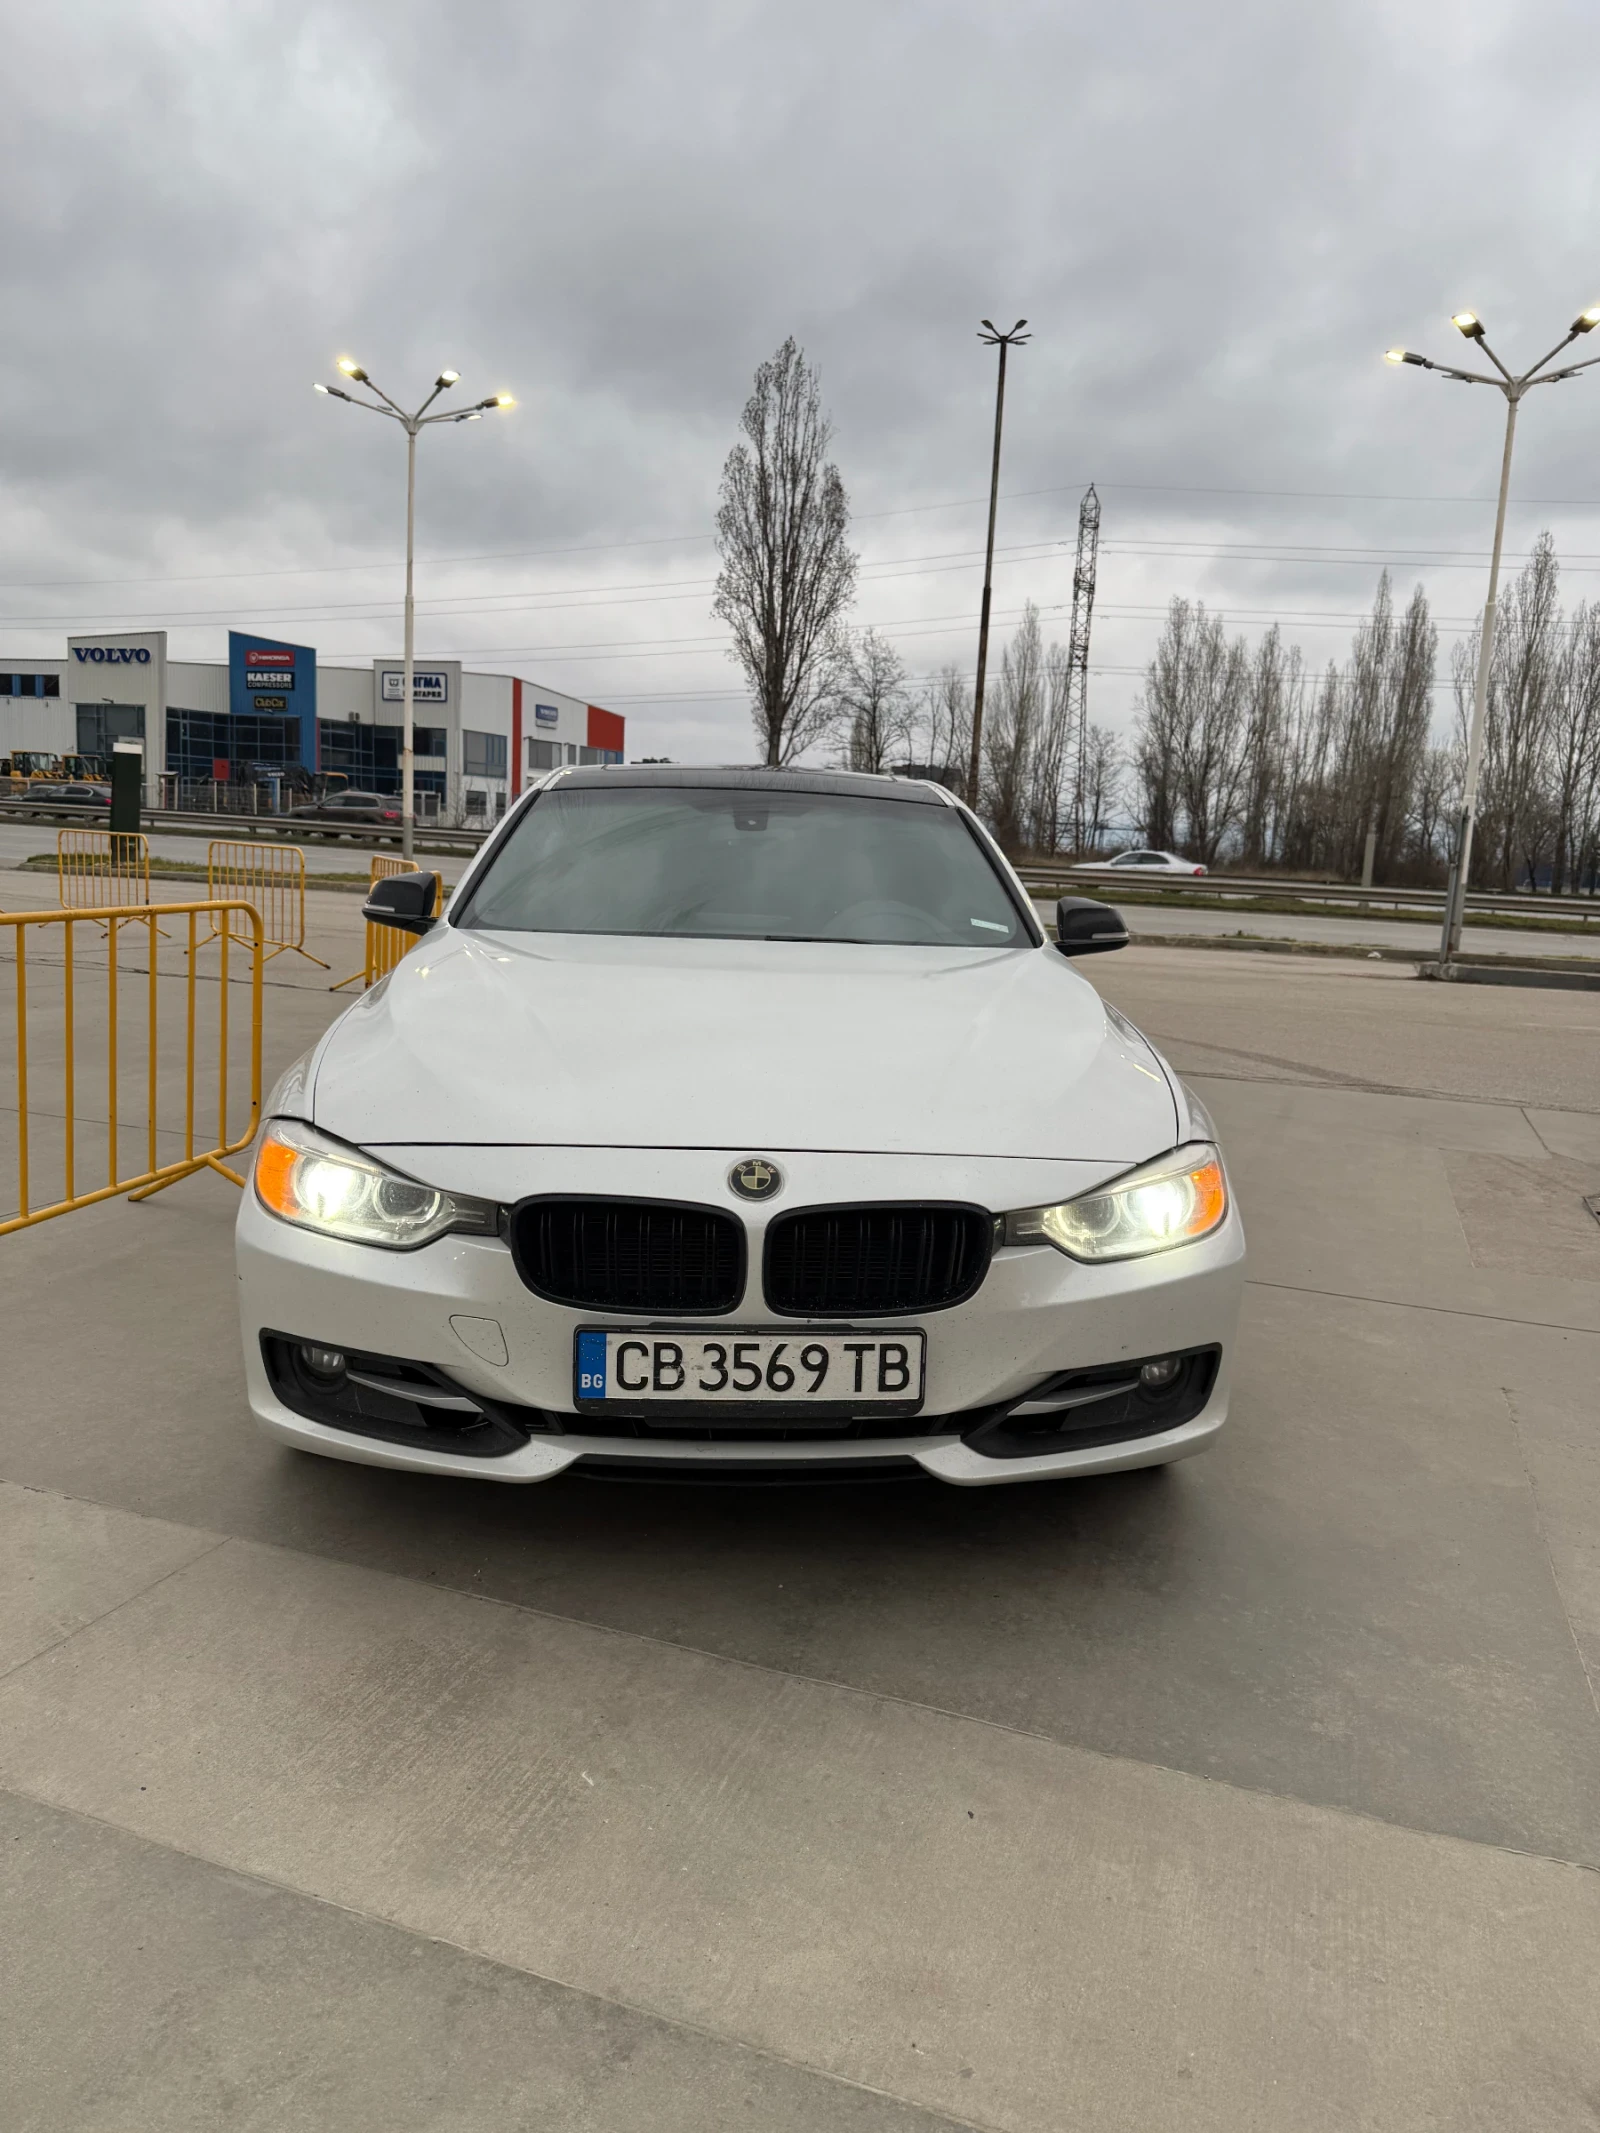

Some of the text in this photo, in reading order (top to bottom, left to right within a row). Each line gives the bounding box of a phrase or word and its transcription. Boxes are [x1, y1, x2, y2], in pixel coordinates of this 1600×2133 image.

[72, 647, 151, 663] VOLVO
[247, 673, 292, 682] KAESER
[737, 1161, 777, 1174] BMW
[616, 1341, 911, 1393] CB 3569 TB
[581, 1373, 604, 1389] BG
